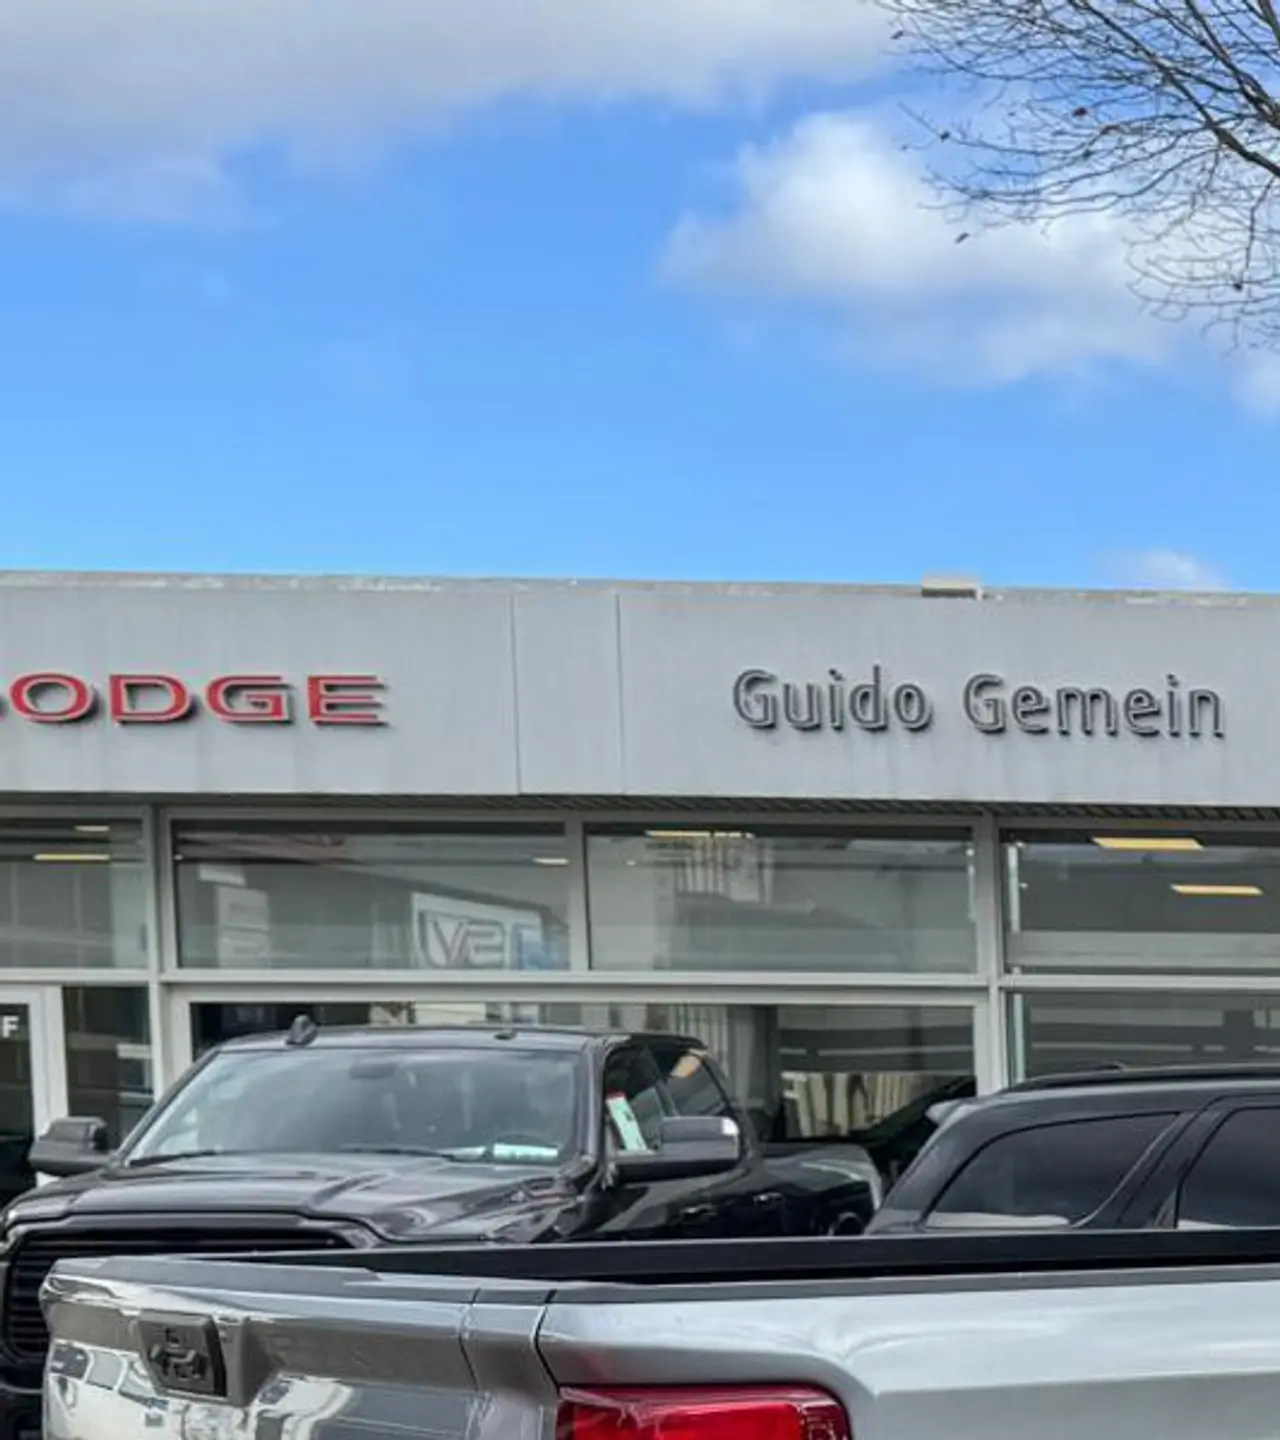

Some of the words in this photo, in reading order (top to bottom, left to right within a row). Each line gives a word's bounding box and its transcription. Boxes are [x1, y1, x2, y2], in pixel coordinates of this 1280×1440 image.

[0, 672, 388, 727] ODGE
[733, 665, 931, 732] Guido
[962, 673, 1225, 738] Gemein
